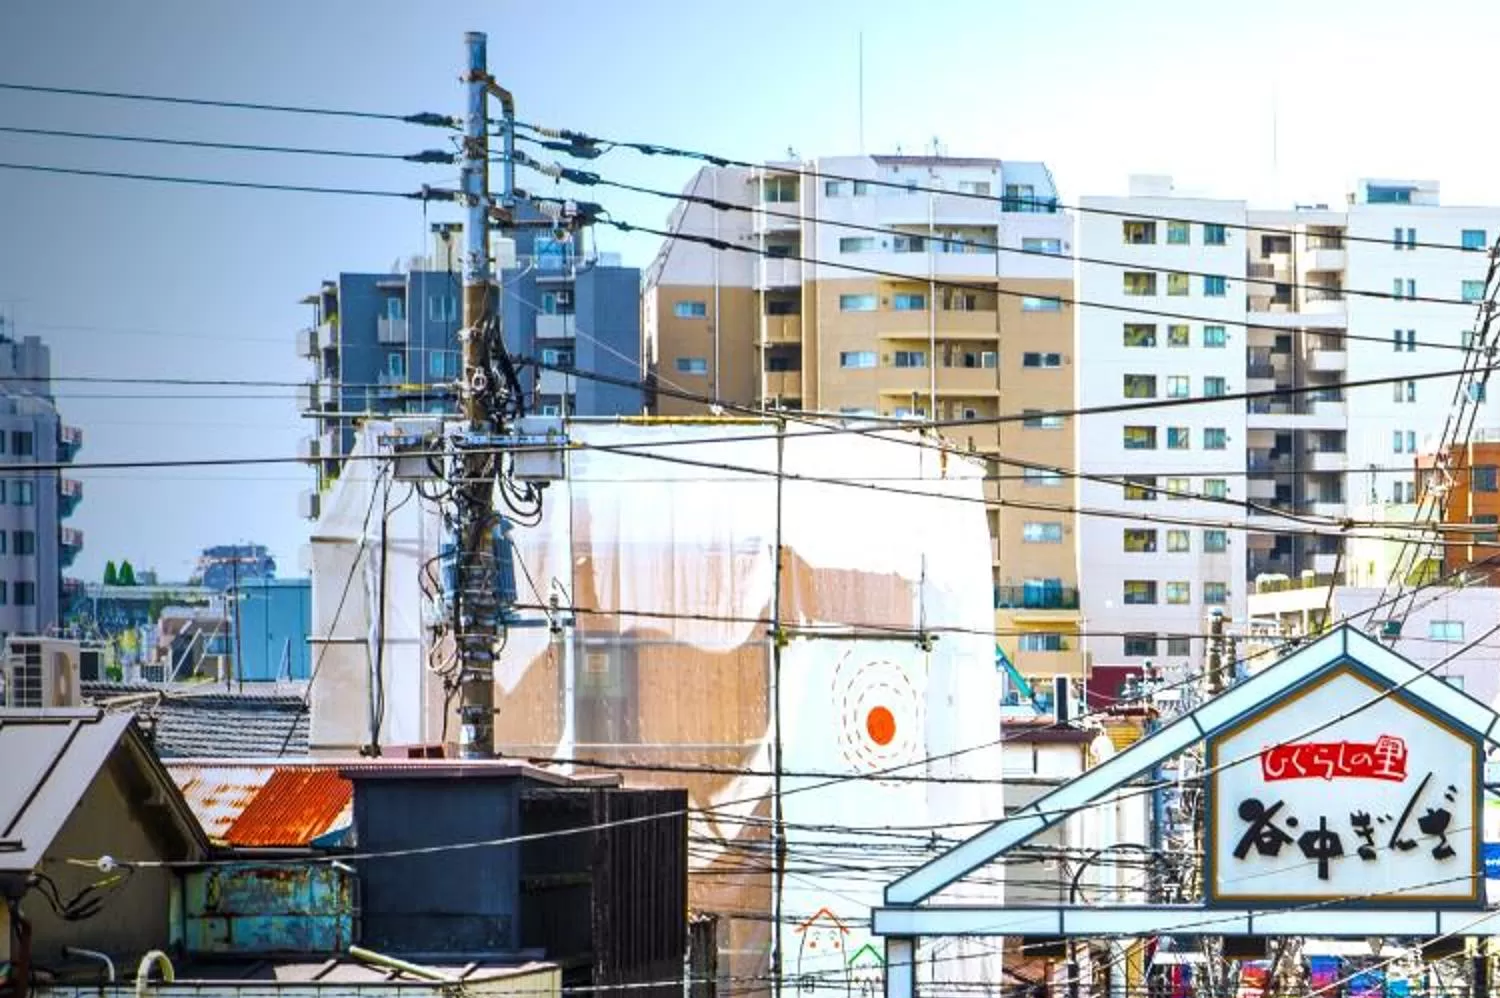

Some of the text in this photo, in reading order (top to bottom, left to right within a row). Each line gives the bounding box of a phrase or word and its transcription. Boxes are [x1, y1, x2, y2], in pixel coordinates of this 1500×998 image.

[1264, 735, 1405, 781] ひぐらしの里
[1232, 771, 1458, 881] 谷中ぎんざ
